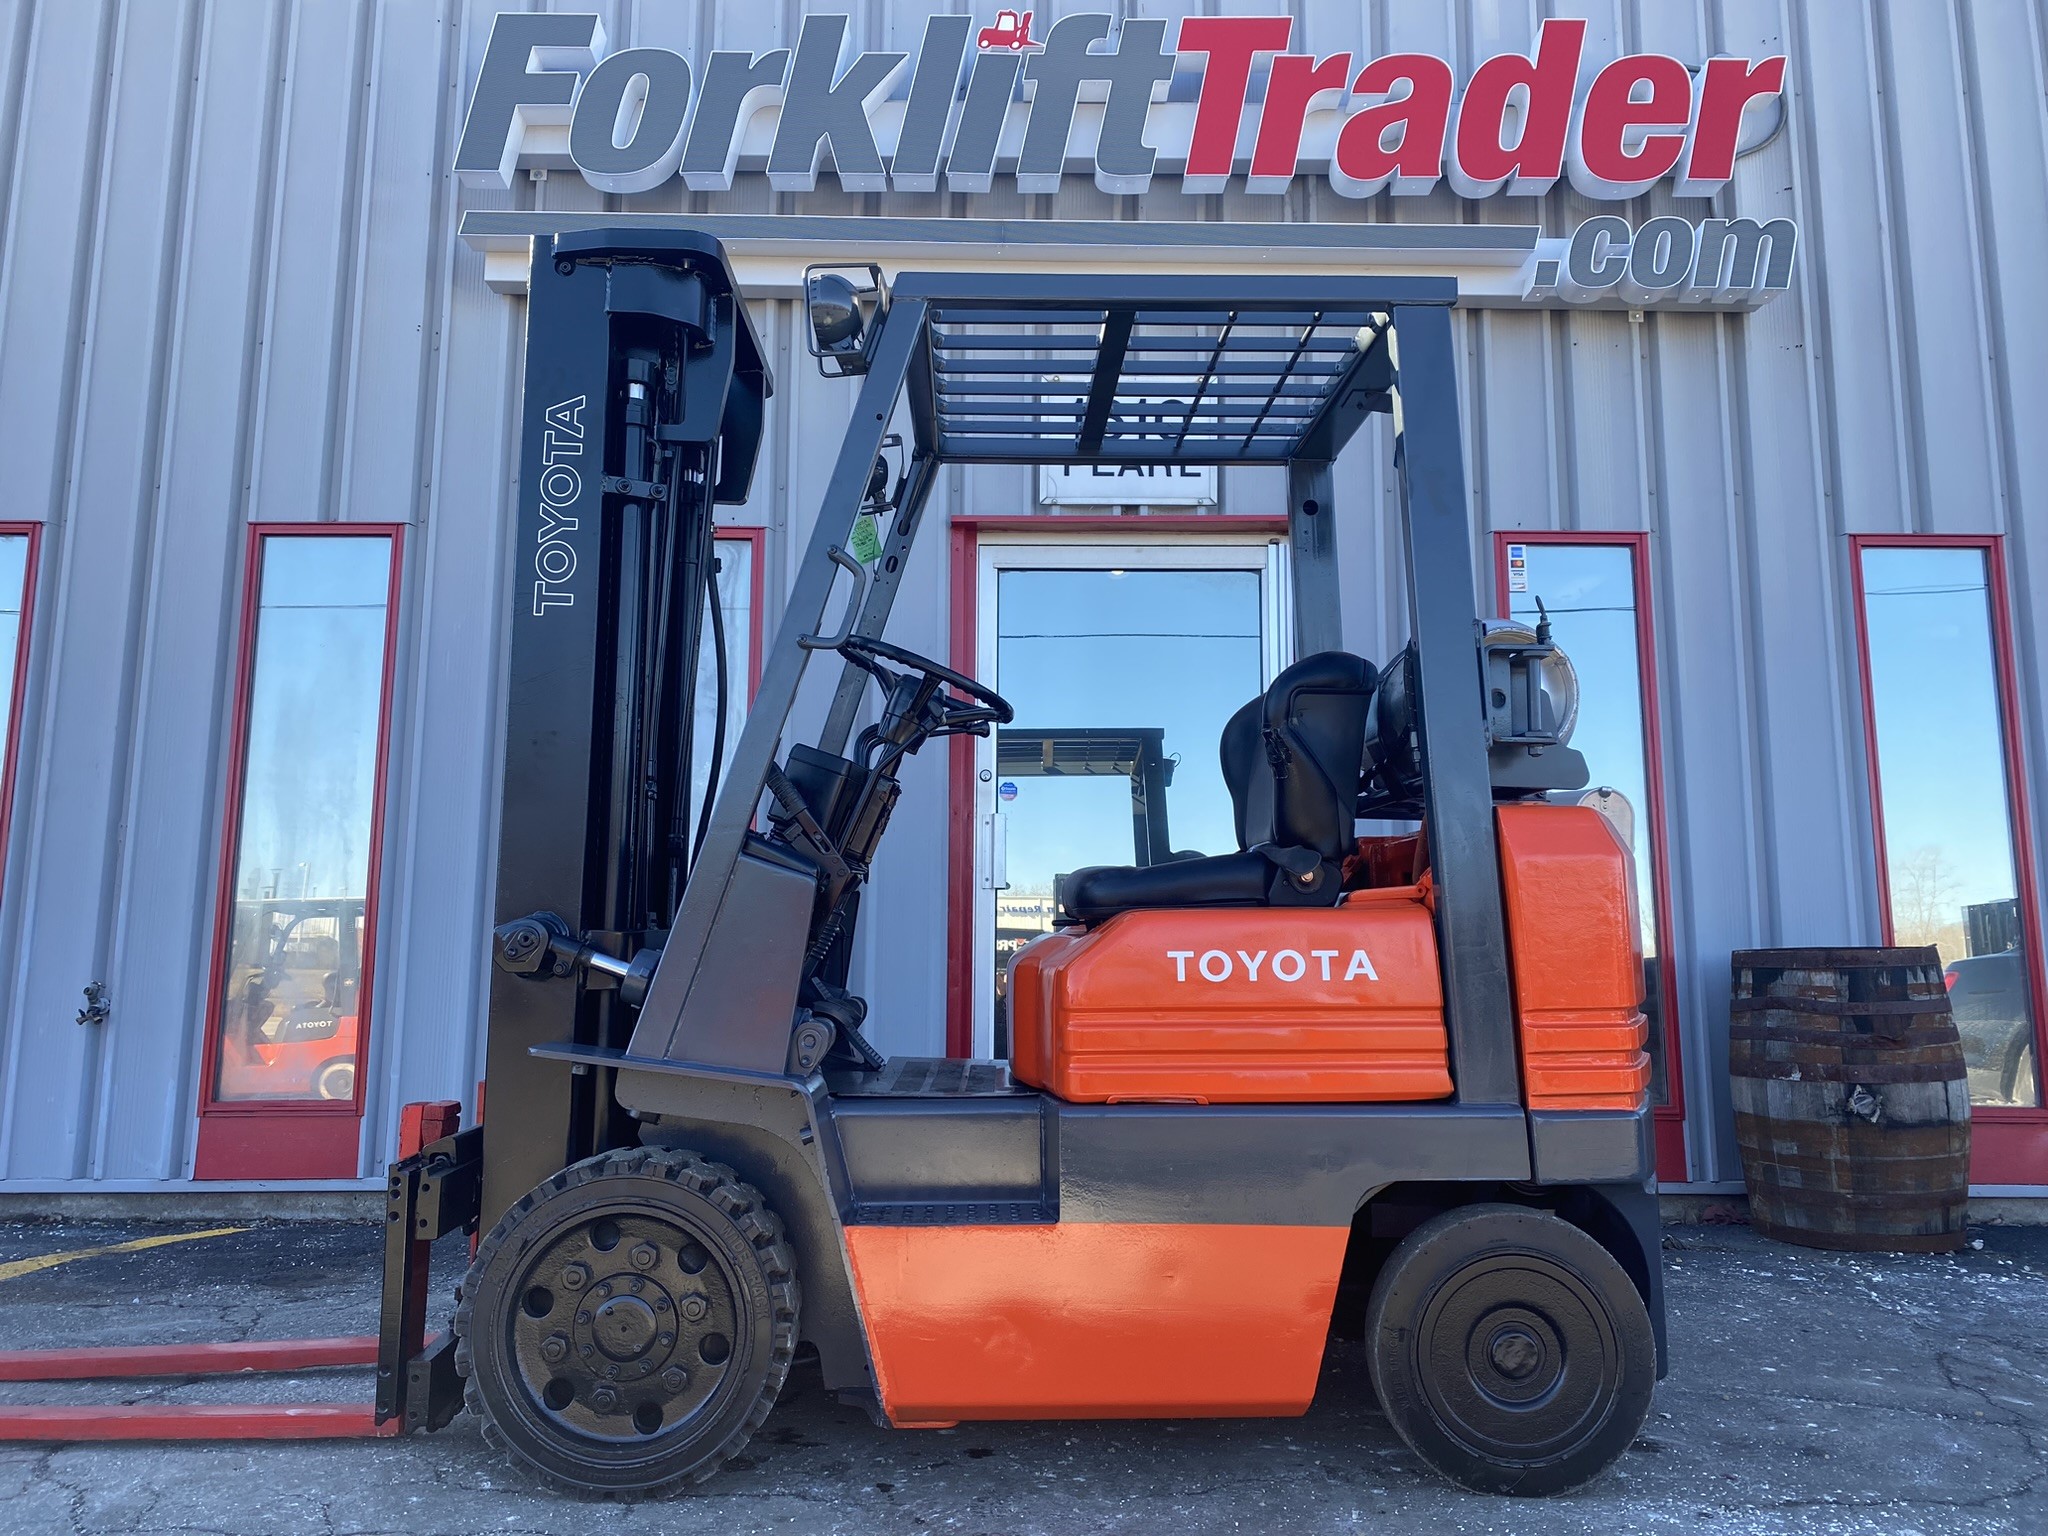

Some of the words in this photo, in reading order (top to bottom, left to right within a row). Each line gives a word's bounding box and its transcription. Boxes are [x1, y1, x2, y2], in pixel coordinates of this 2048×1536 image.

[1533, 214, 1798, 290] .com
[533, 394, 586, 616] TOYOTA
[1167, 949, 1379, 982] TOYOTA
[720, 1222, 752, 1263] WIDE
[745, 1261, 771, 1321] TRACK
